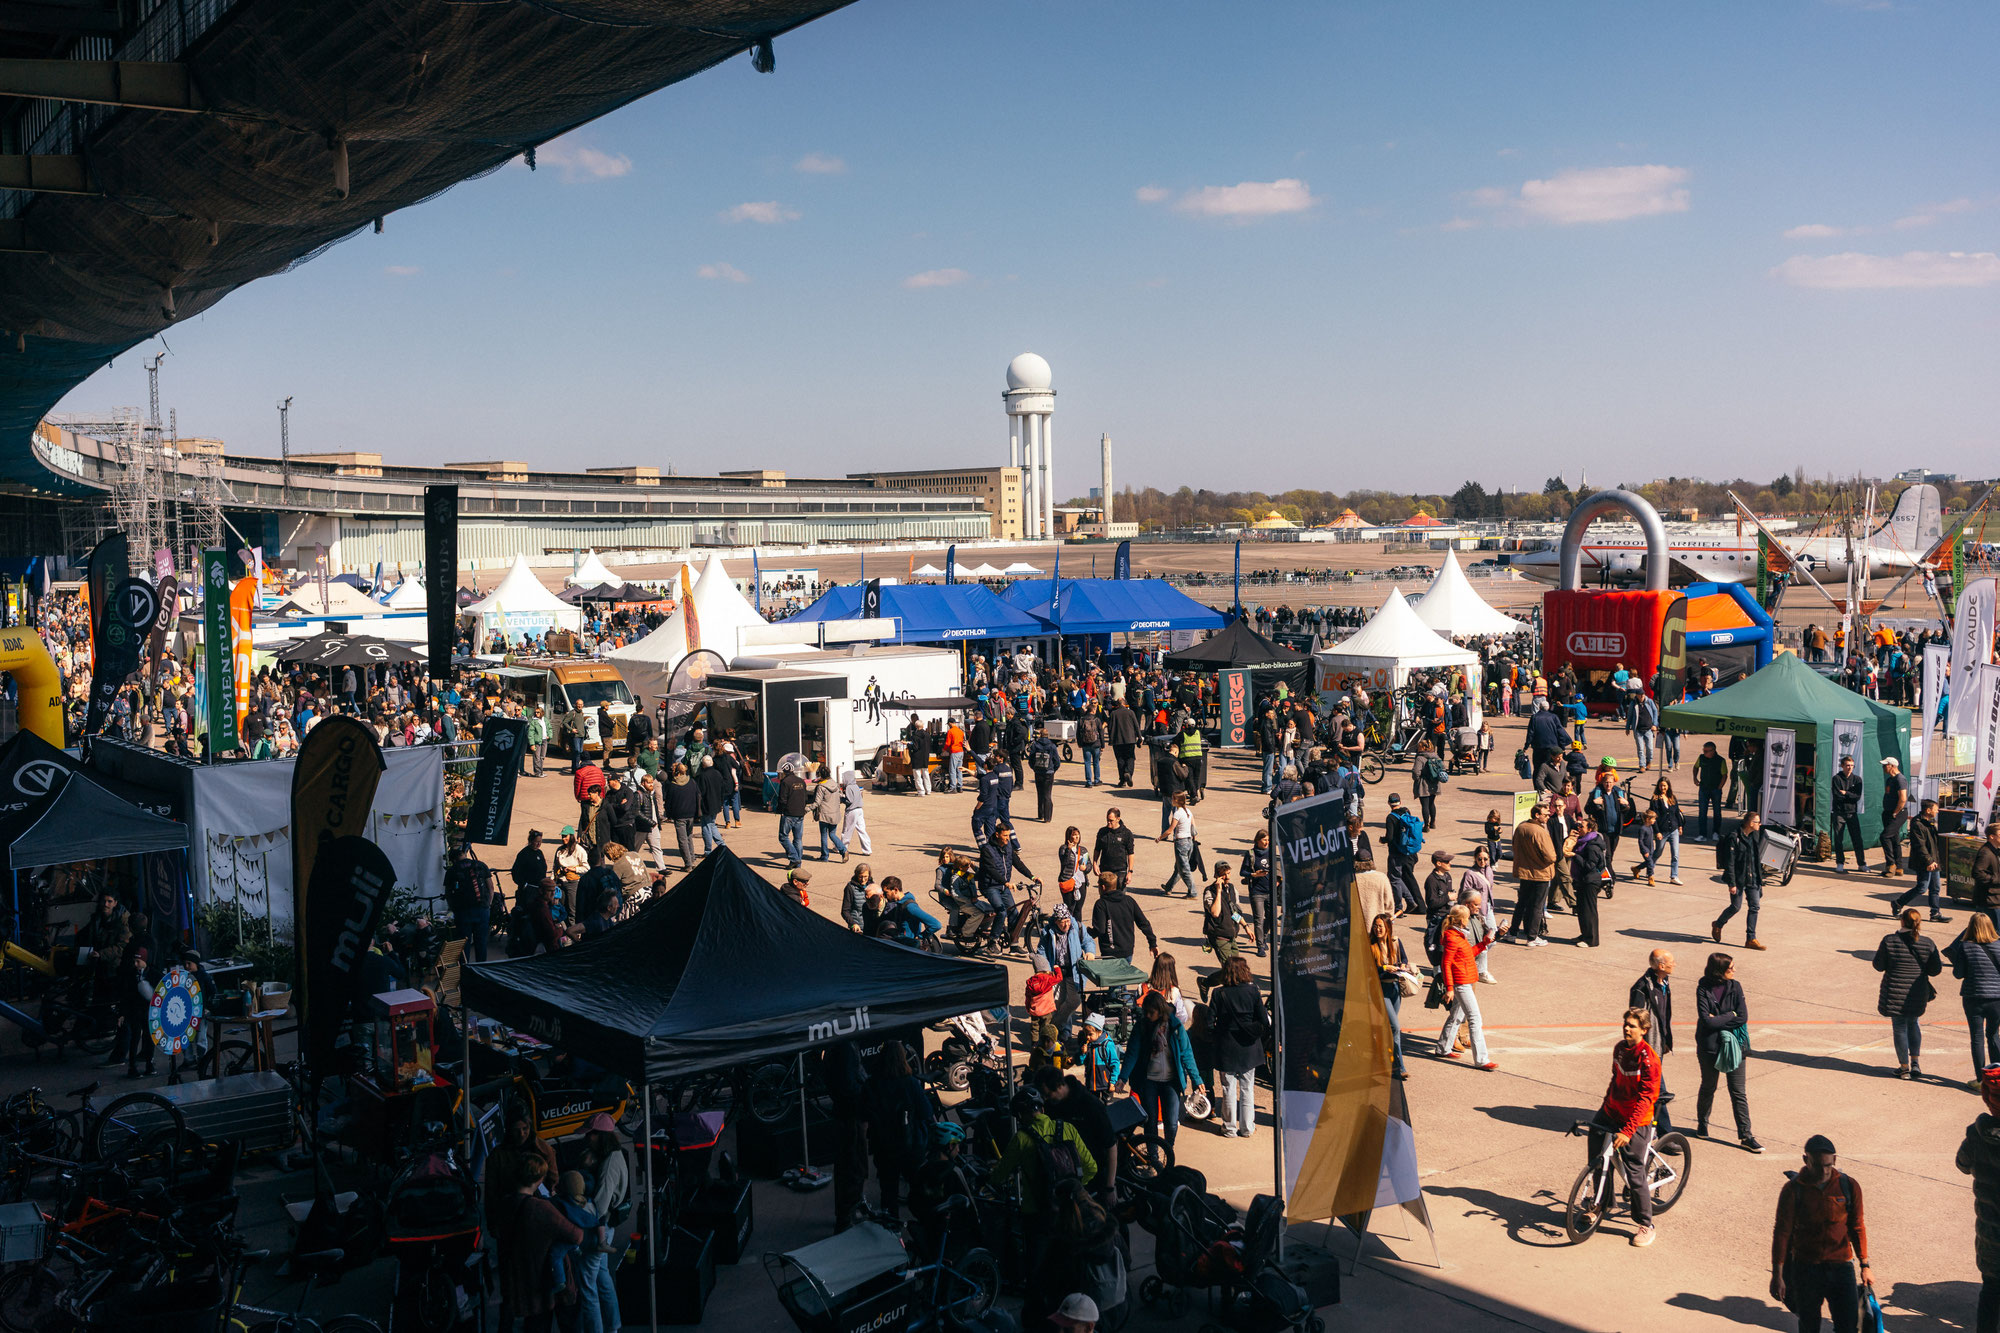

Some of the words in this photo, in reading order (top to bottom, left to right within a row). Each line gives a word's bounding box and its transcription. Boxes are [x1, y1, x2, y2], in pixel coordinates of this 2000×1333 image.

[1954, 545, 1962, 599] helbaude.de
[493, 616, 550, 627] AVENTURE
[951, 628, 987, 637] DECATHLON
[1138, 621, 1170, 629] DECATHLON
[1967, 595, 1978, 651] VAUDE
[2, 637, 25, 652] ADAC
[1574, 636, 1621, 653] ABUS
[1713, 634, 1731, 643] ABUS
[217, 603, 233, 738] IUMENTUM
[48, 696, 62, 708] AD
[1230, 673, 1244, 725] TYPE
[1729, 722, 1757, 734] Serea
[326, 735, 356, 828] CARGO
[485, 765, 503, 841] IUMENTUM
[1286, 824, 1348, 864] VELOGUT
[330, 864, 384, 974] muli
[807, 1004, 871, 1042] muli
[541, 1100, 592, 1119] VELOGUT
